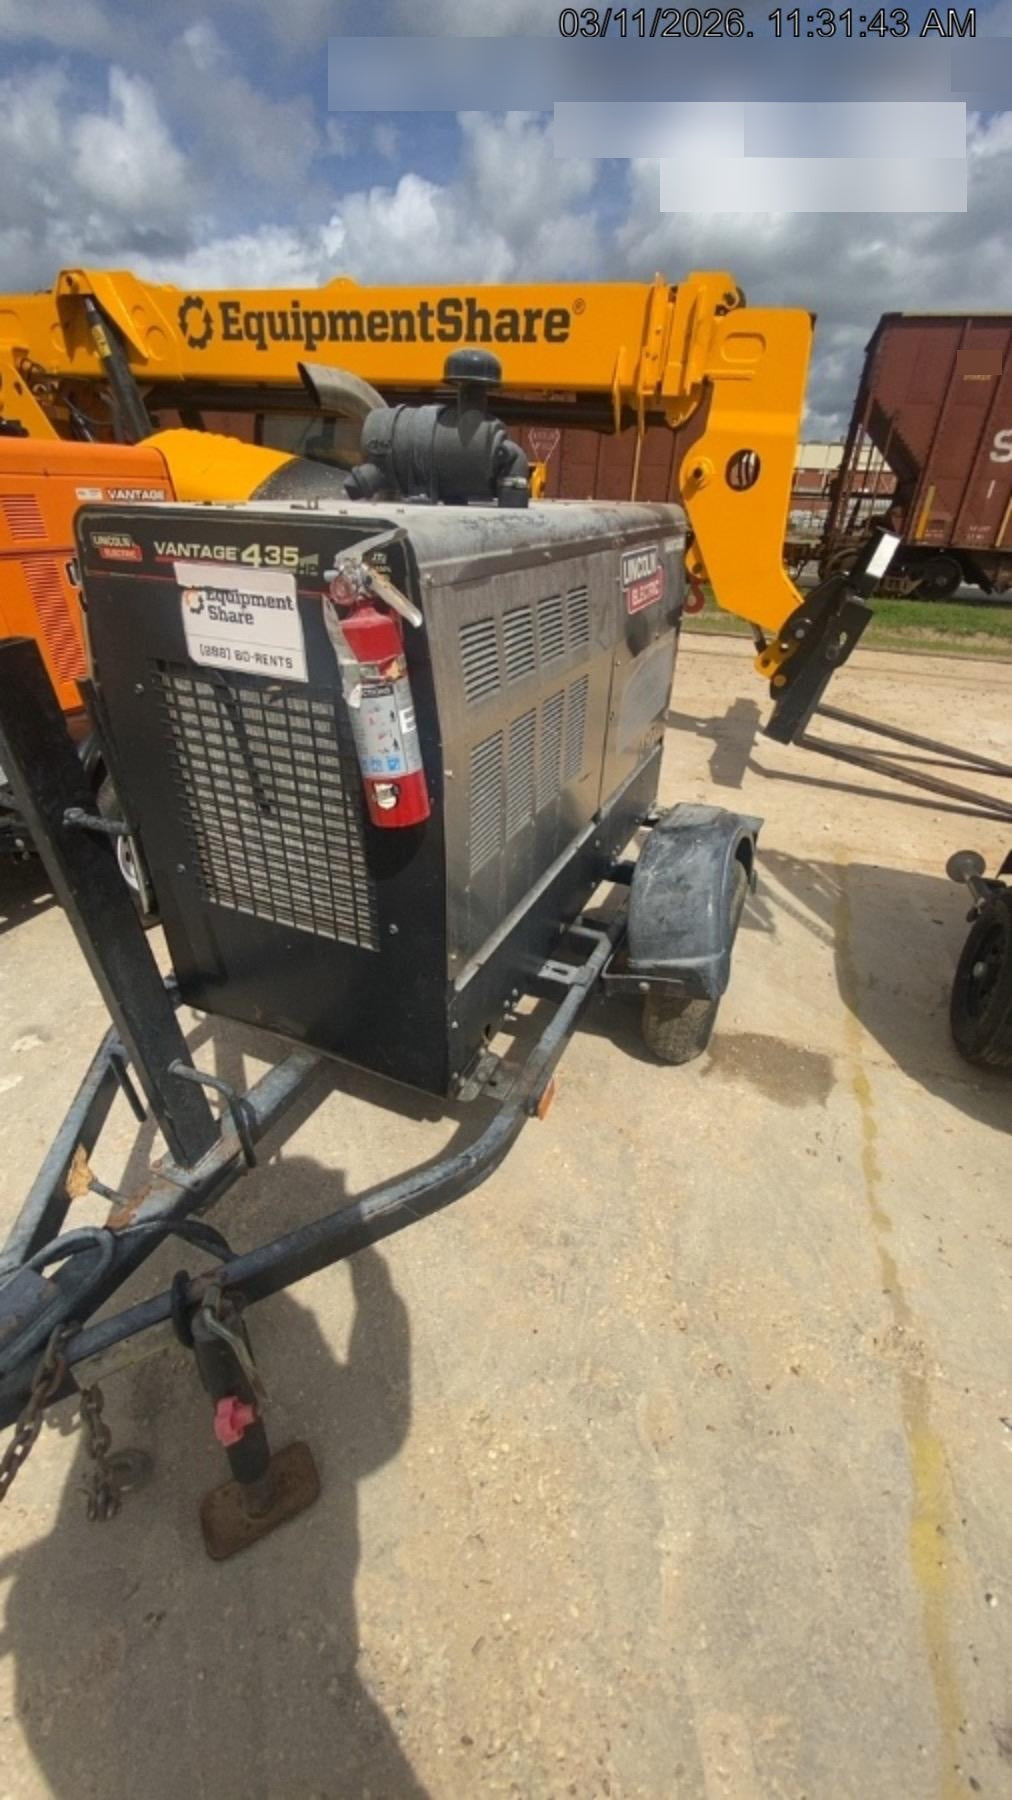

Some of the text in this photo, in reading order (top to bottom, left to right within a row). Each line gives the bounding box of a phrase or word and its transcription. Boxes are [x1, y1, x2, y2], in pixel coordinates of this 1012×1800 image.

[107, 489, 165, 500] VANTAGE
[153, 540, 238, 561] VANTAGE
[240, 543, 300, 569] 435
[623, 550, 657, 585] LINCOLN
[631, 580, 660, 606] ELECTRIC
[207, 605, 255, 626] Share
